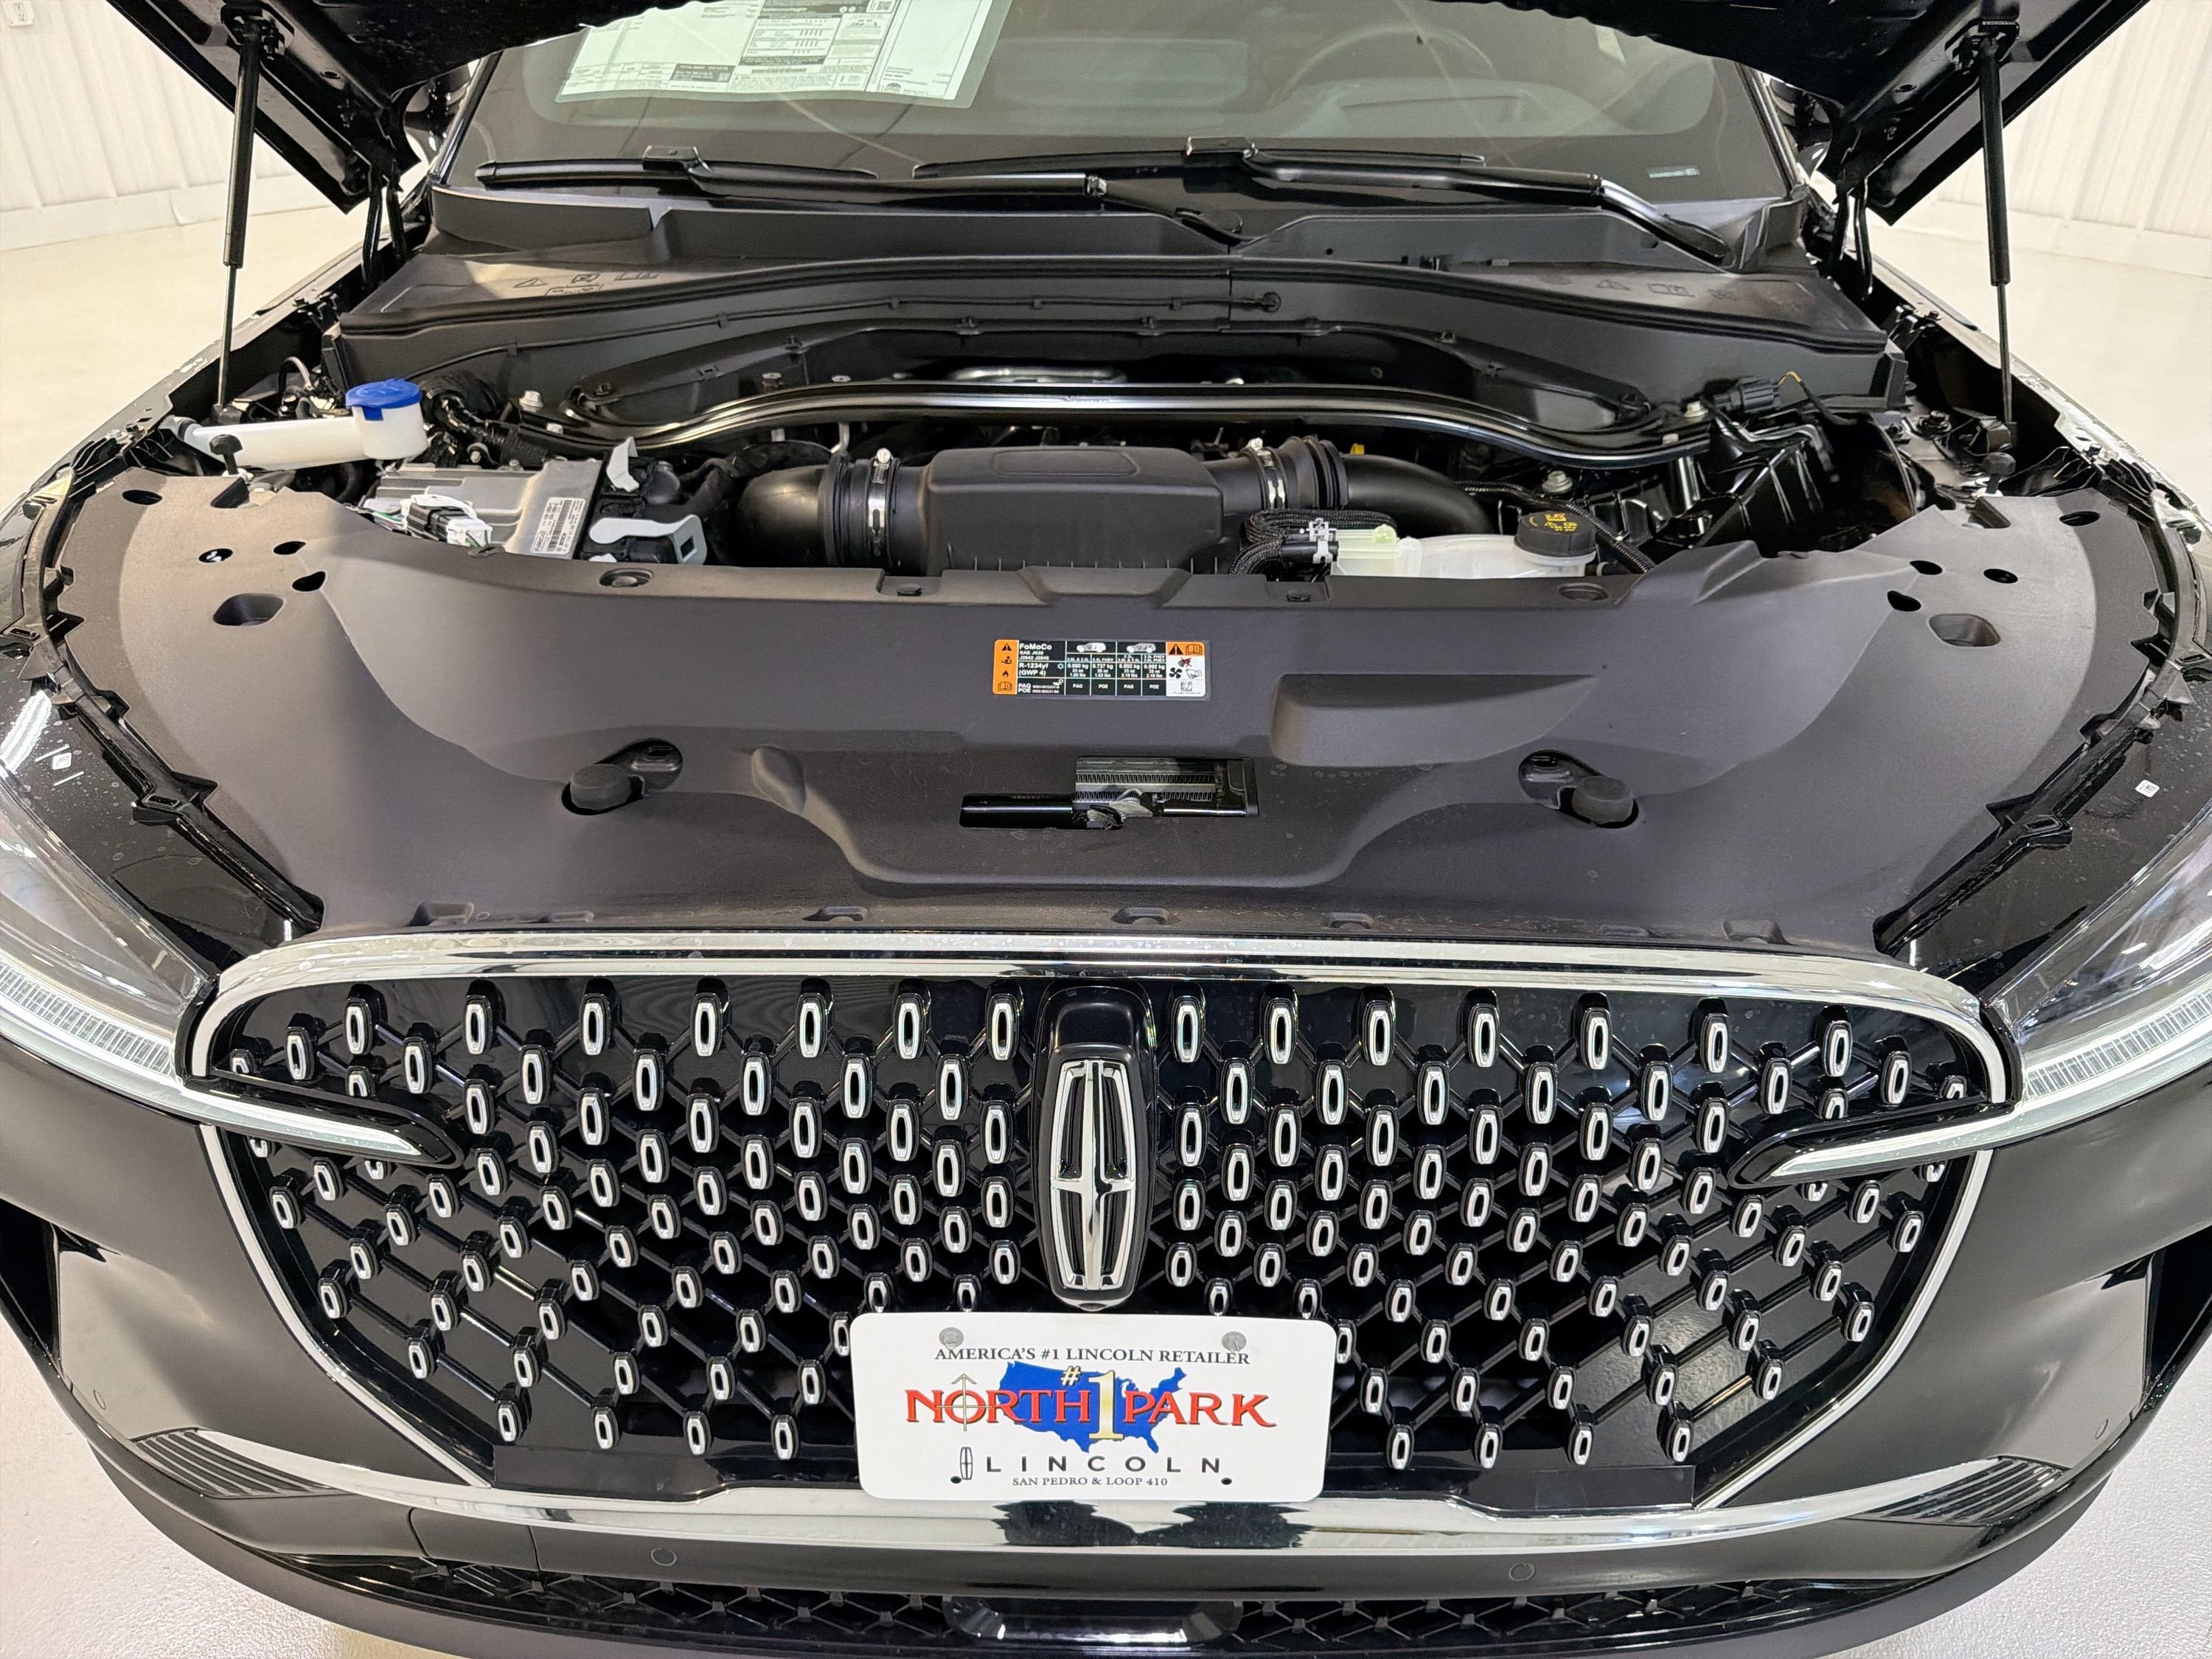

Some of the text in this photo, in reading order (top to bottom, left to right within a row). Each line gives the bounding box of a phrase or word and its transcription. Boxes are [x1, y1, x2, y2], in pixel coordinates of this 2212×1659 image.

[934, 1347, 1251, 1365] AMERICA'S #1 LINCOLN RETAILER
[905, 1388, 1278, 1428] NORTH PARK
[986, 1455, 1221, 1474] LINCOLN
[1012, 1476, 1169, 1486] SAN PEDRO & LOOP 410
